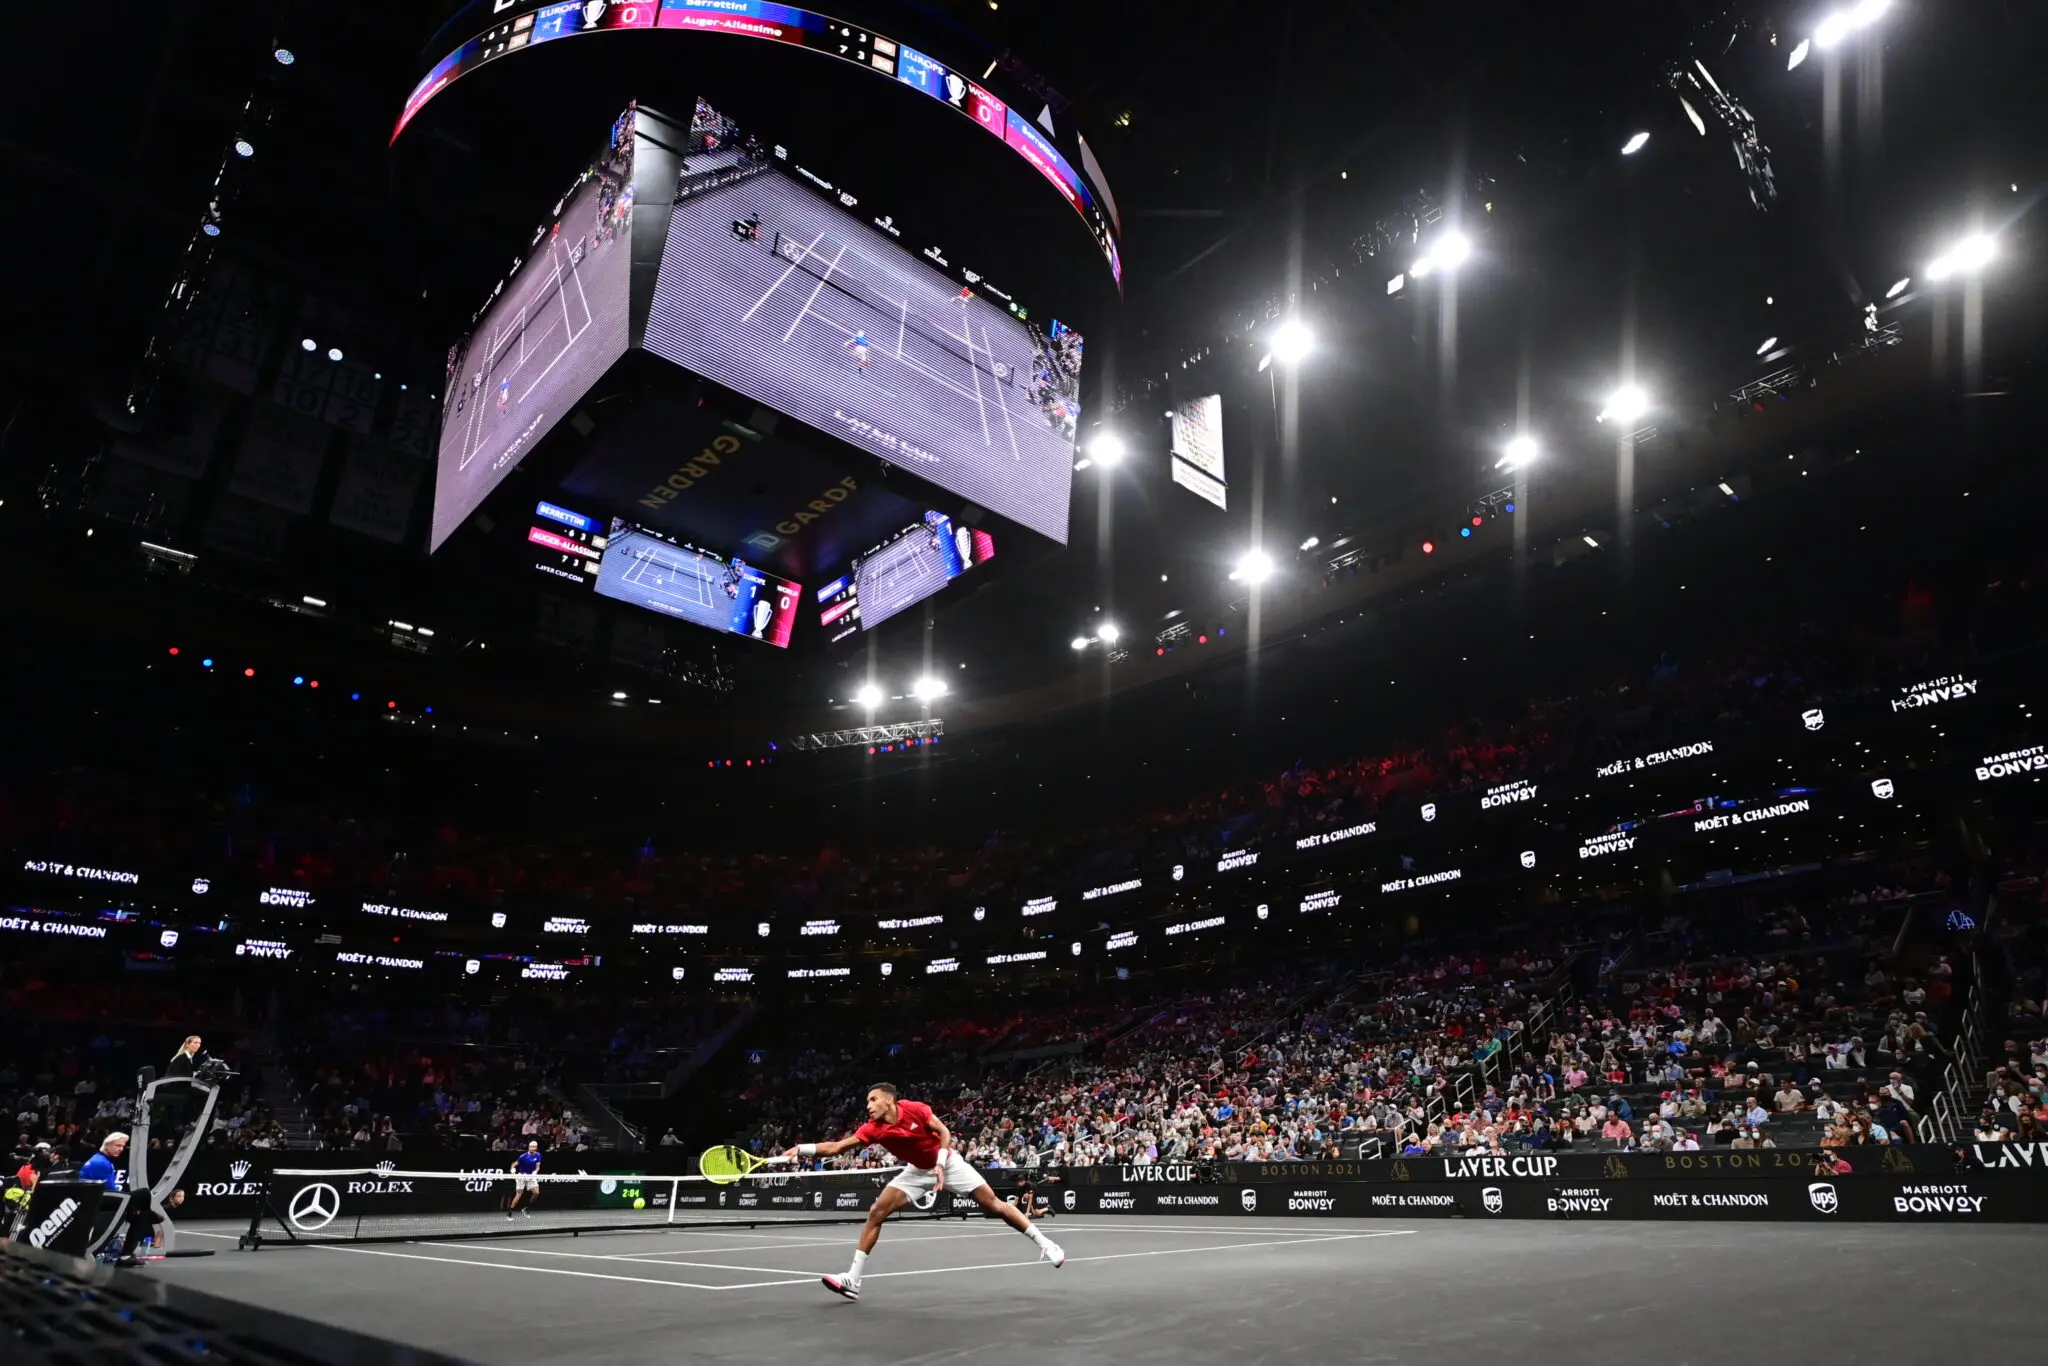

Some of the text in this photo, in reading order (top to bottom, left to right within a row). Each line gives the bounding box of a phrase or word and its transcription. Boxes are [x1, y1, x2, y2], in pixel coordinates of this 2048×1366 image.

[540, 2, 581, 18] EUROPE
[622, 7, 637, 23] 0
[553, 18, 562, 32] 1
[682, 15, 783, 38] Auger-Aliassime
[841, 28, 850, 37] 6
[859, 33, 867, 43] 3
[839, 44, 849, 54] 7
[857, 50, 865, 60] 3
[903, 49, 946, 76] EUROPE
[918, 70, 926, 86] 1
[968, 83, 1003, 112] WORLD
[979, 104, 991, 122] 0
[540, 505, 586, 527] BERRETTINI
[532, 532, 601, 560] AUGER-ALIASSIME
[780, 596, 790, 610] 0
[1646, 741, 1713, 765] CHANDON
[1983, 746, 2043, 764] MARRIOTT
[1481, 786, 1537, 809] BONVOY
[1743, 800, 1809, 822] CHANDON
[1585, 831, 1626, 845] MARRIOTT
[1579, 837, 1637, 858] BONVOY
[1218, 853, 1257, 872] BONVOY
[1416, 869, 1461, 886] CHANDON
[270, 887, 310, 898] MARRIOTT
[1305, 890, 1334, 901] MARRIOTT
[1022, 901, 1057, 916] BONVOY
[1300, 896, 1341, 912] BONVOY
[43, 923, 106, 937] CHANDON
[544, 923, 591, 933] BONVOY
[666, 925, 708, 933] CHANDON
[801, 925, 840, 935] BONVOY
[246, 939, 286, 948] MARRIOTT
[1107, 936, 1139, 950] BONVOY
[529, 962, 563, 970] MARRIOTT
[926, 963, 960, 973] BONVOY
[522, 968, 570, 980] BONVOY
[714, 972, 754, 981] BONVOY
[1444, 1156, 1510, 1178] LAVER
[1666, 1153, 1815, 1168] BOSTON 202
[1122, 1166, 1163, 1182] LAVER
[1262, 1164, 1361, 1176] BOSTON 2021
[347, 1181, 413, 1194] ROLEX
[1902, 1185, 1968, 1195] MARRIOTT
[1100, 1199, 1134, 1209] BONVOY
[1184, 1196, 1218, 1205] CHANDON
[1289, 1199, 1333, 1210] BONVOY
[1399, 1196, 1405, 1205] &
[1407, 1195, 1455, 1206] CHANDON
[1484, 1191, 1501, 1211] ups
[1691, 1196, 1701, 1206] &
[1703, 1194, 1768, 1206] CHANDON
[1812, 1192, 1835, 1209] ups
[1894, 1196, 1983, 1213] BONVOY
